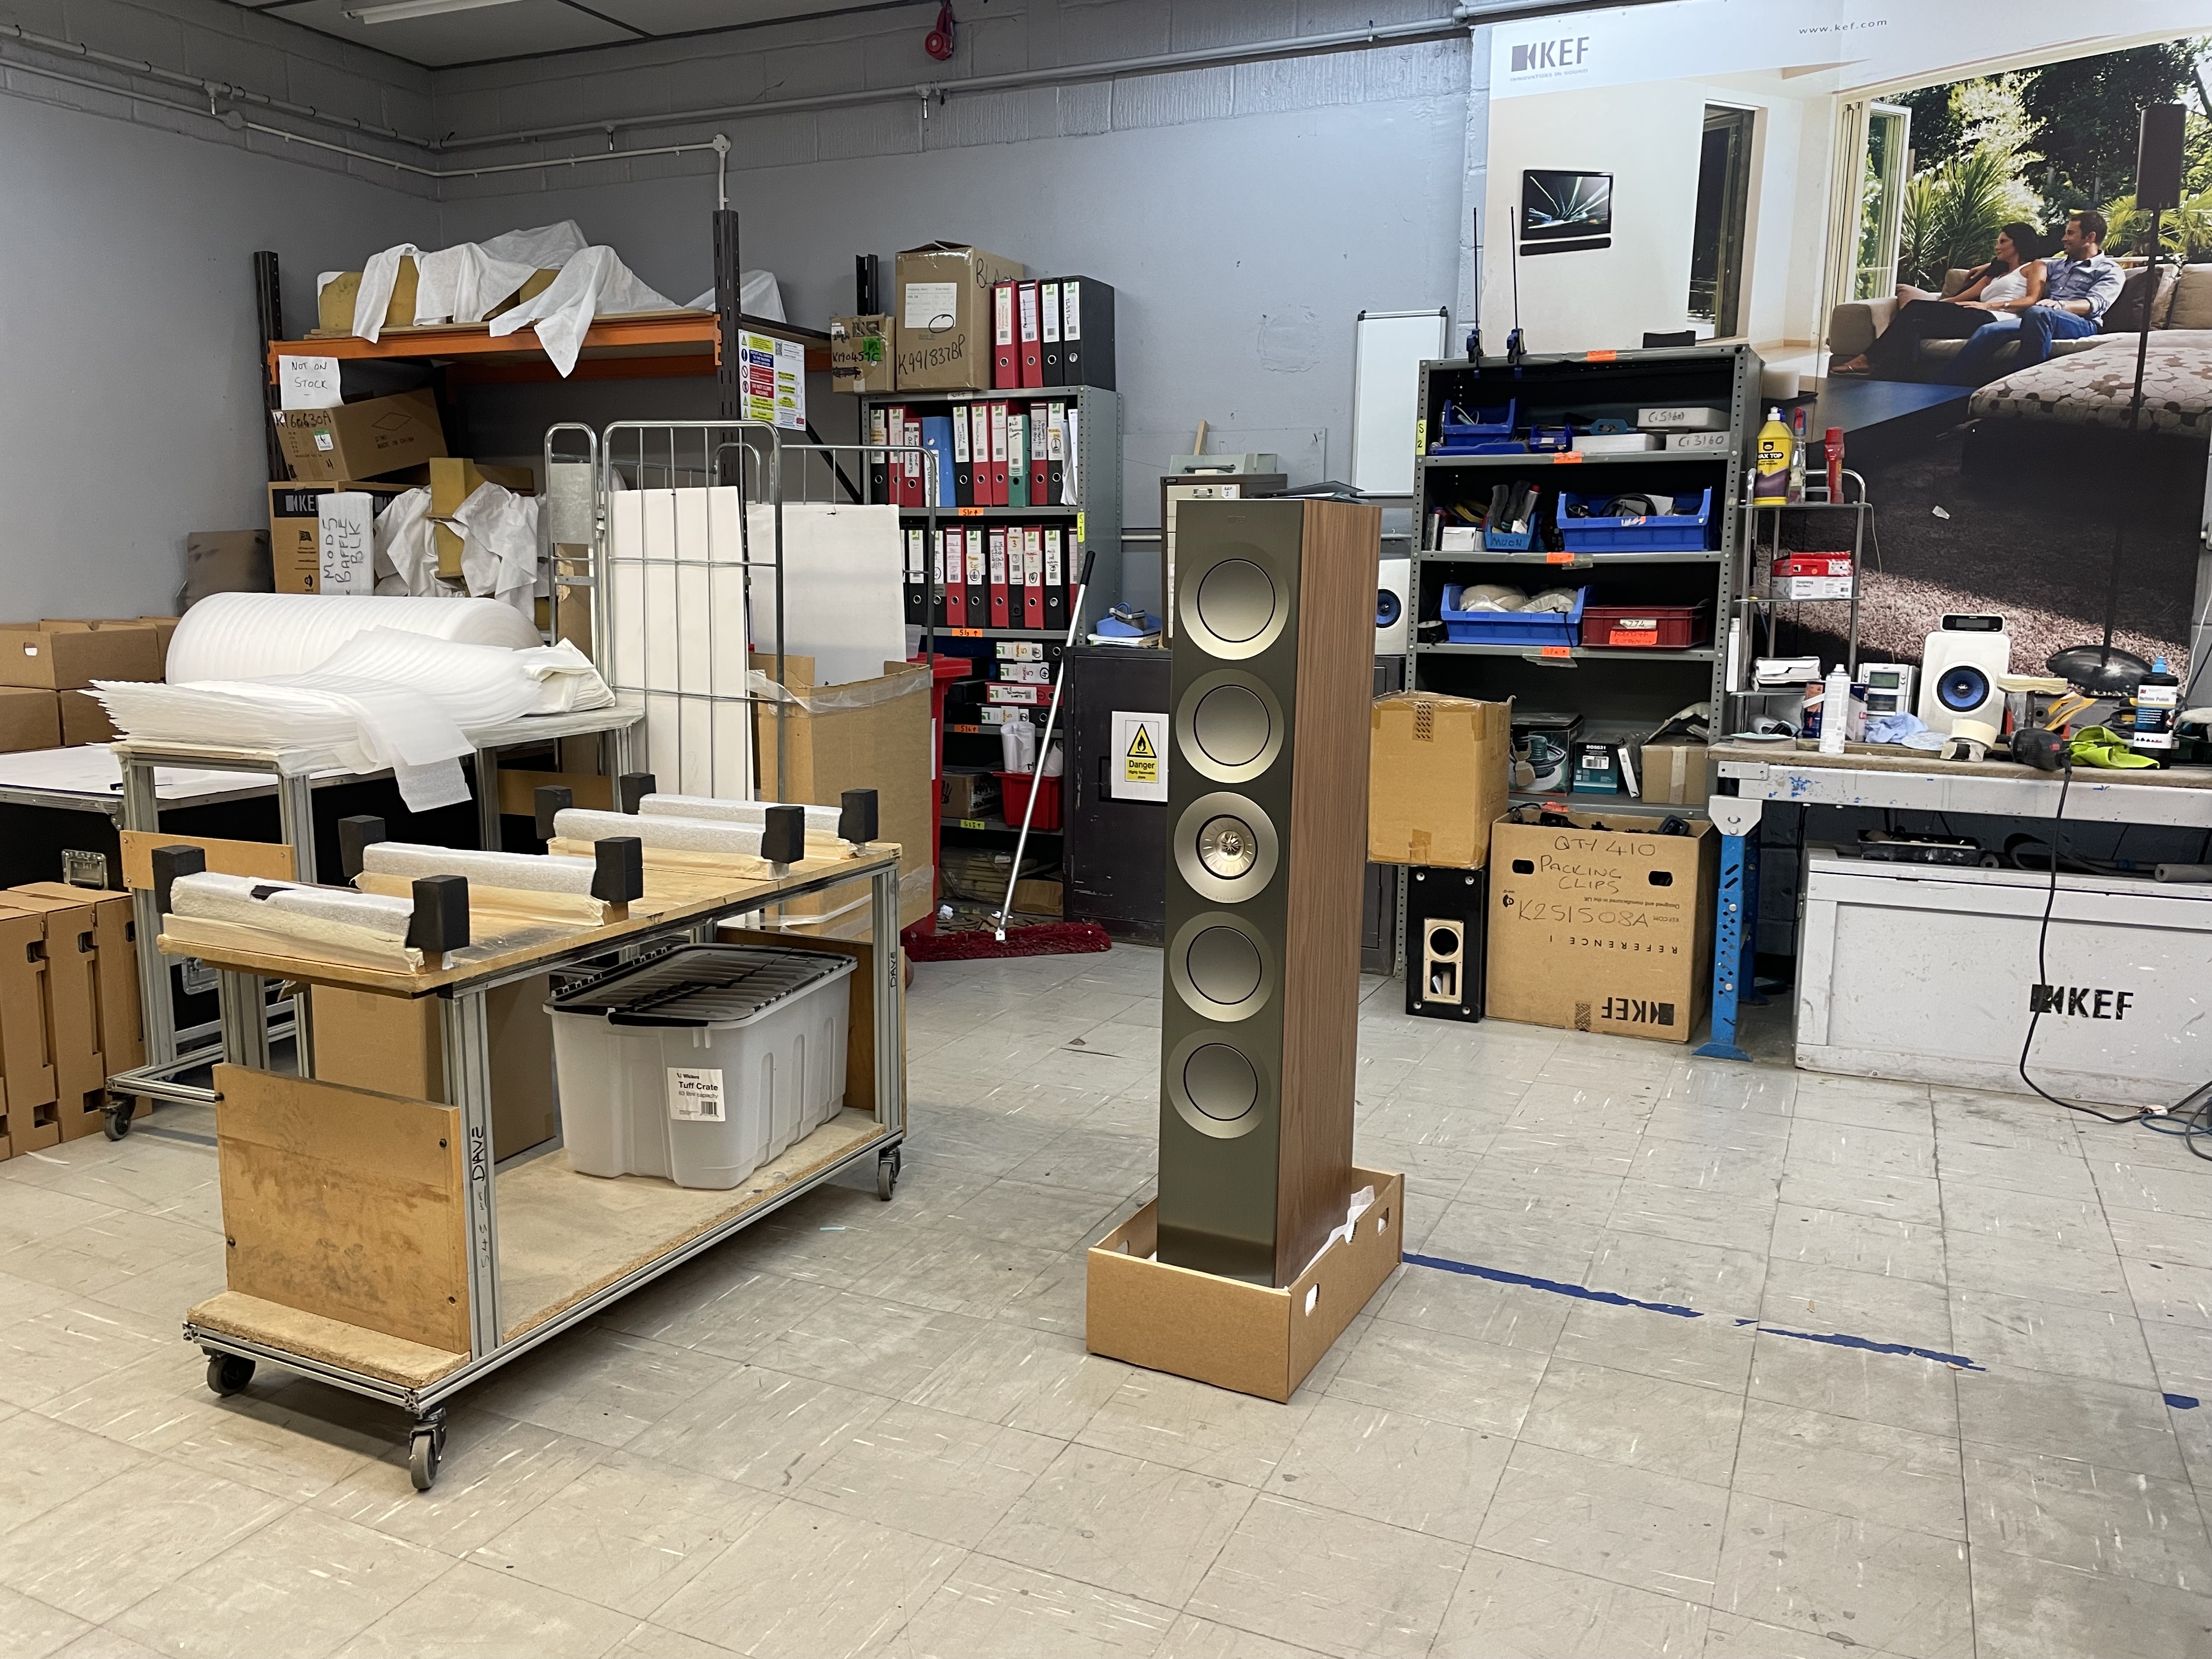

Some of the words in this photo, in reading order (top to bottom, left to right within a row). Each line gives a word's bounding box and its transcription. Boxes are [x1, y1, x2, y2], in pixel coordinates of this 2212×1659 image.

[1799, 20, 1887, 34] www.kef.com
[1540, 36, 1590, 69] KEF
[1510, 73, 1553, 82] INNOVATORS
[291, 362, 308, 370] NOT
[314, 362, 328, 370] ON
[294, 377, 328, 389] STOCK
[335, 518, 351, 583] BAFFLE
[348, 520, 363, 564] BLK
[1129, 760, 1155, 770] Danger
[1606, 840, 1656, 856] 410
[1559, 876, 1619, 895] CLIPS
[1569, 936, 1678, 955] REFERENCE
[1601, 997, 1647, 1023] KEF
[2068, 987, 2134, 1020] KEF
[678, 1081, 695, 1089] Tuff
[696, 1082, 719, 1091] Crate
[471, 1125, 485, 1182] DAVE
